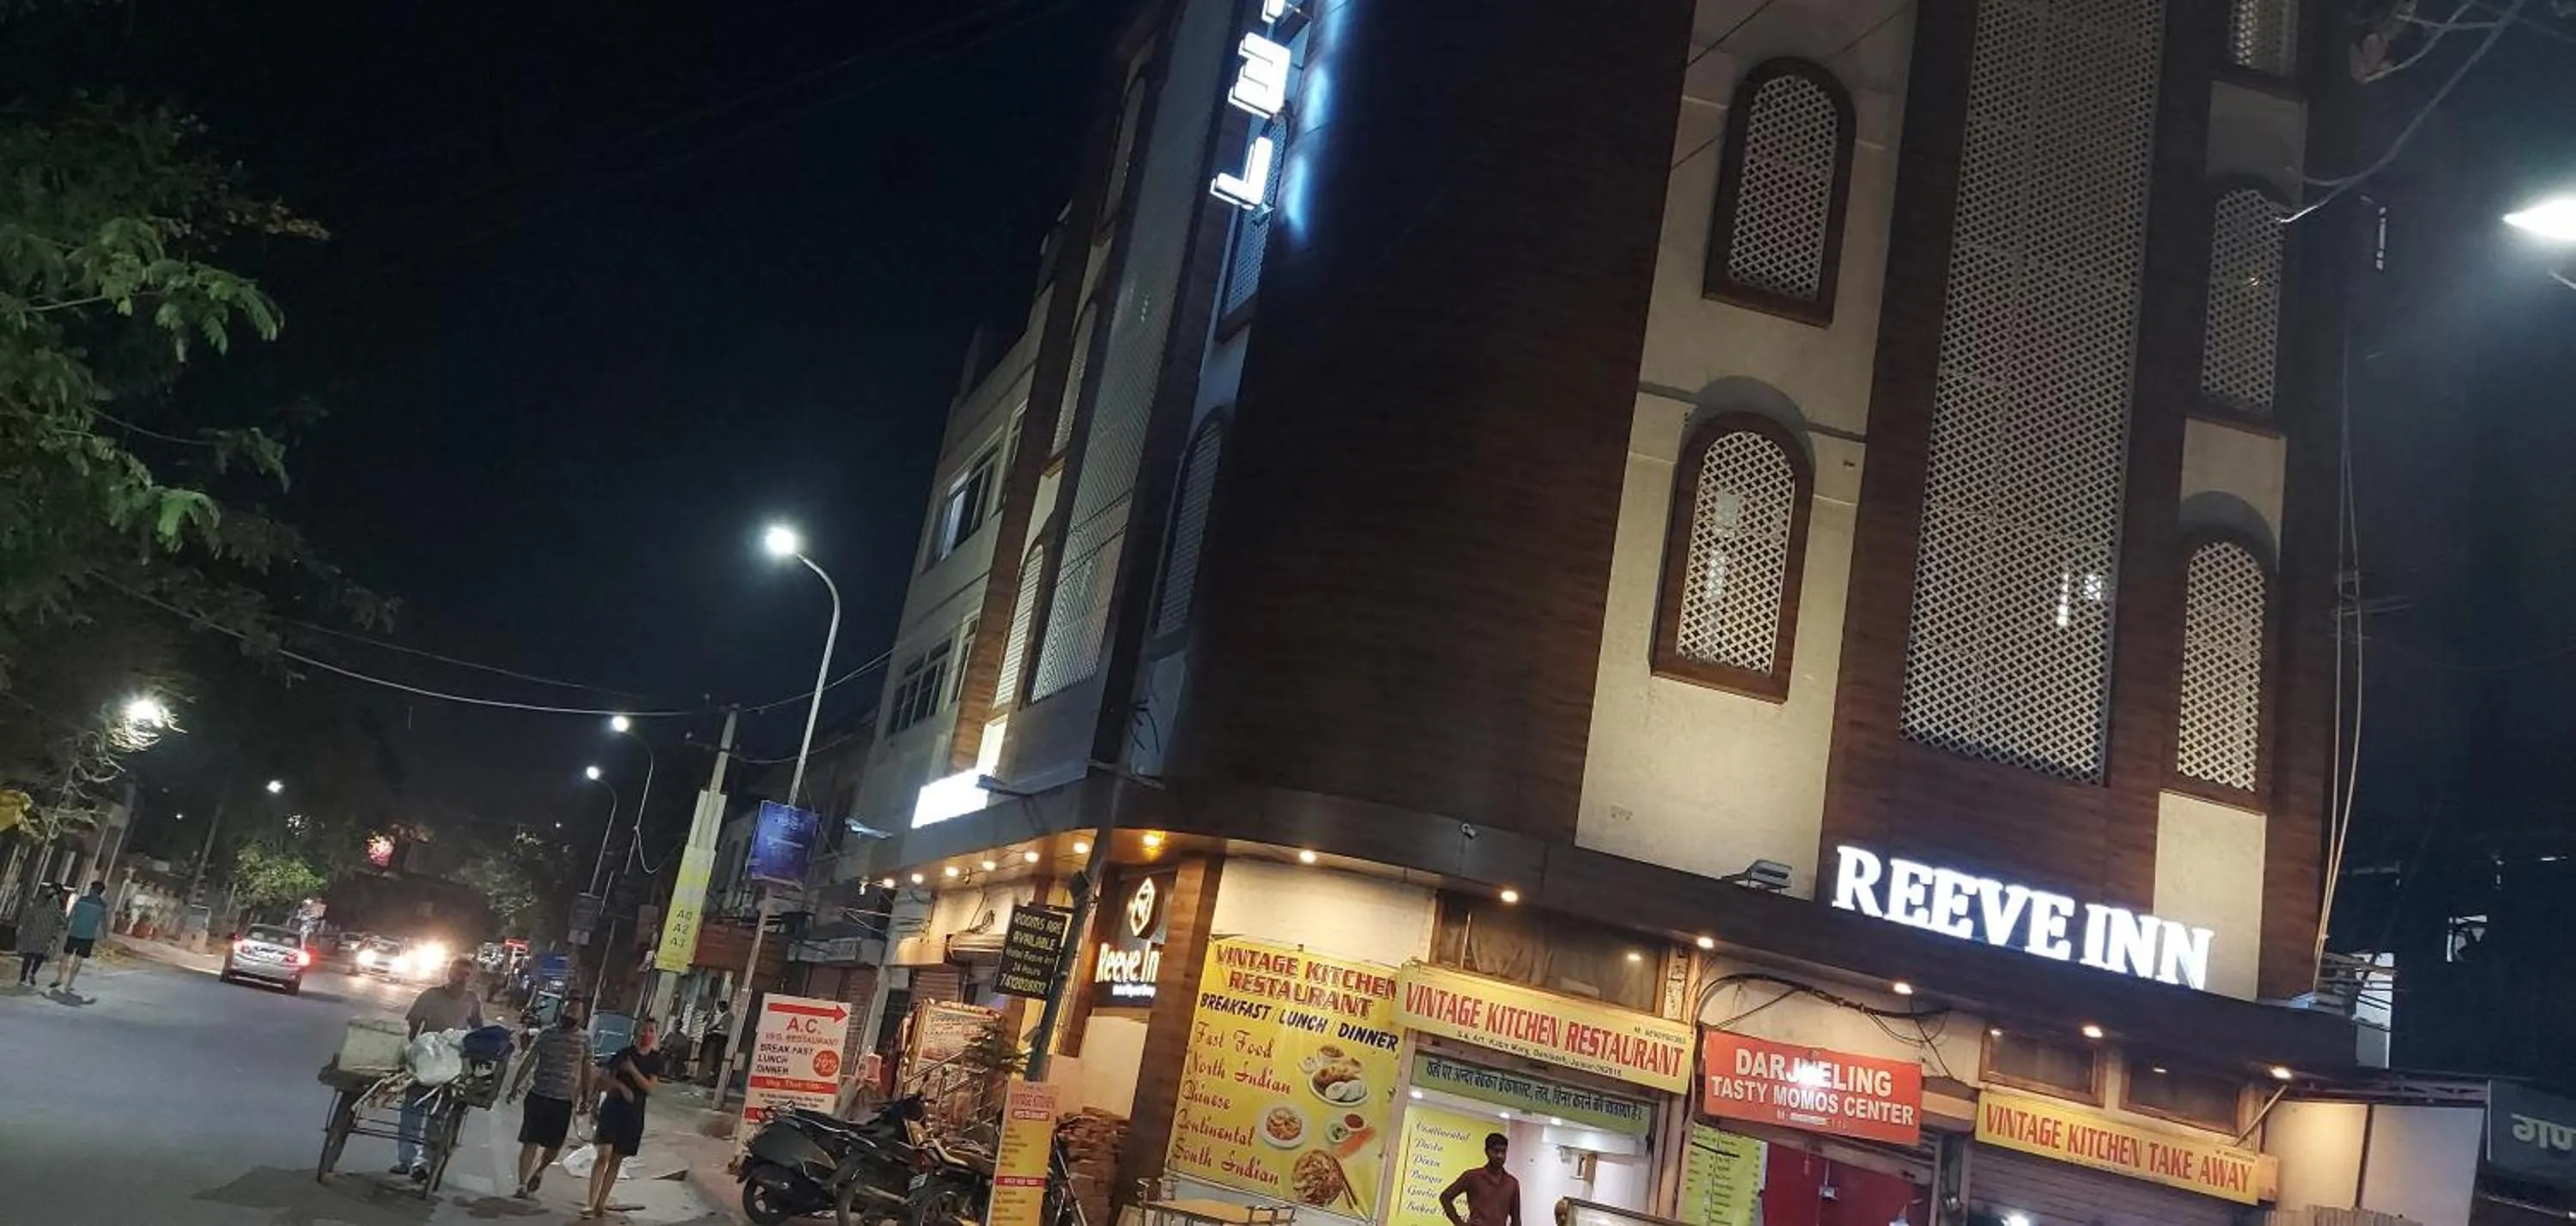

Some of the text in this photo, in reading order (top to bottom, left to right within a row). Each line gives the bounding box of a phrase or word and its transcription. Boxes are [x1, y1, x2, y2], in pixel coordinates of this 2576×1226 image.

[1832, 845, 2215, 990] REEVE INN
[1095, 943, 1140, 983] Reeve
[1217, 944, 1398, 1000] VINTAGE KITCHEN
[1200, 992, 1272, 1020] BREAKFAST
[1279, 1010, 1328, 1034] LUNCH
[1229, 970, 1374, 1019] RESTAURANT
[787, 1017, 822, 1035] A.C.
[1197, 1020, 1275, 1059] Fast Food
[1406, 981, 1685, 1077] VINTAGE KITCHEN RESTAURANT
[757, 1053, 788, 1064] LUNCH
[760, 1043, 790, 1053] BREAK
[756, 1064, 789, 1075] DINNER
[1188, 1051, 1291, 1094] North Indian
[1735, 1049, 1892, 1096] DARJELING
[1182, 1079, 1230, 1109] Chinese
[1710, 1076, 1767, 1105] TASTY
[1773, 1085, 1838, 1114] MOMOS
[1844, 1096, 1915, 1126] CENTER
[1176, 1108, 1255, 1147] Continental
[1985, 1103, 2063, 1151] VINTAGE
[2067, 1124, 2143, 1168] KITCHEN
[2148, 1143, 2193, 1180] TAKE
[2198, 1155, 2252, 1193] AWAY
[1173, 1137, 1279, 1185] South Indian
